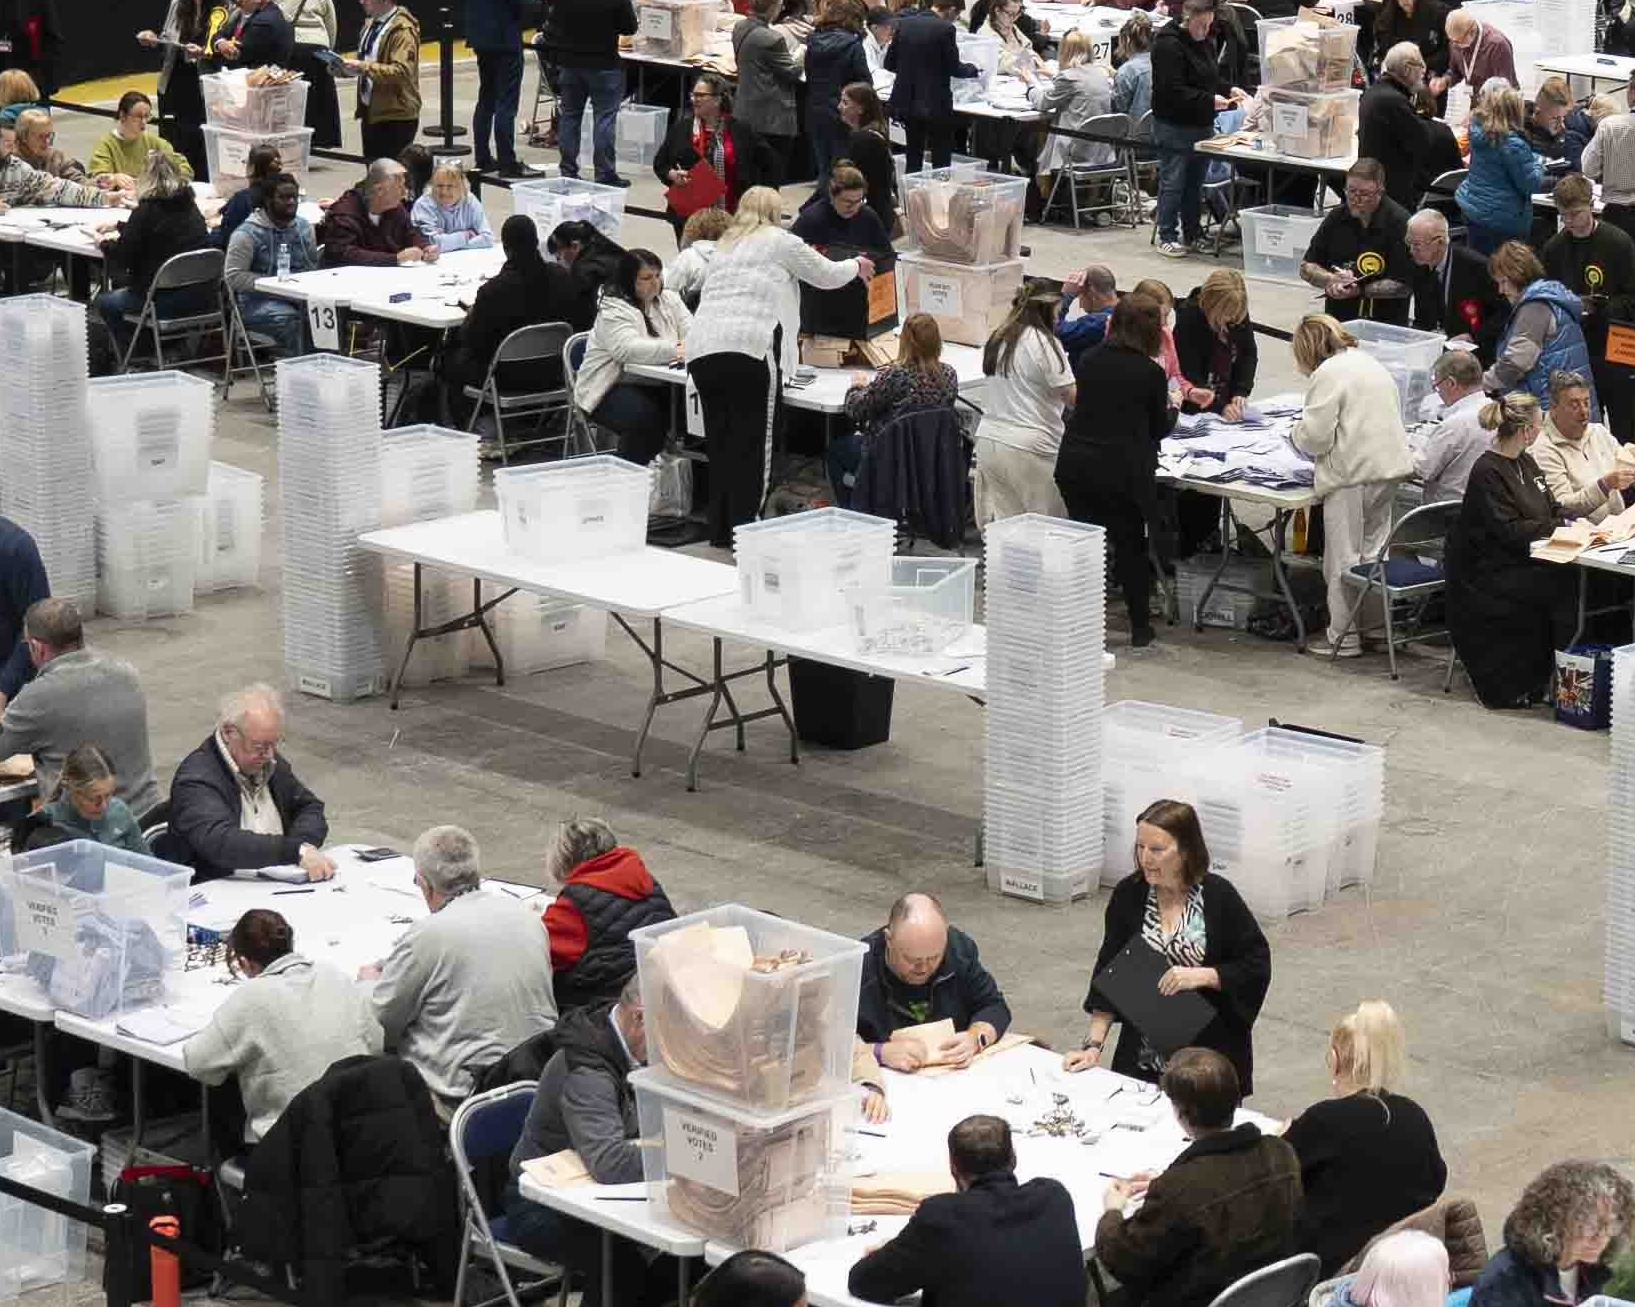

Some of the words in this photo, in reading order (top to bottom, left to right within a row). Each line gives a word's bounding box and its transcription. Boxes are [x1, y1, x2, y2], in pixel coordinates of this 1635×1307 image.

[1092, 42, 1110, 60] 27
[310, 307, 335, 331] 13
[682, 1123, 718, 1142] VERIFIED
[687, 1137, 715, 1153] VOTES
